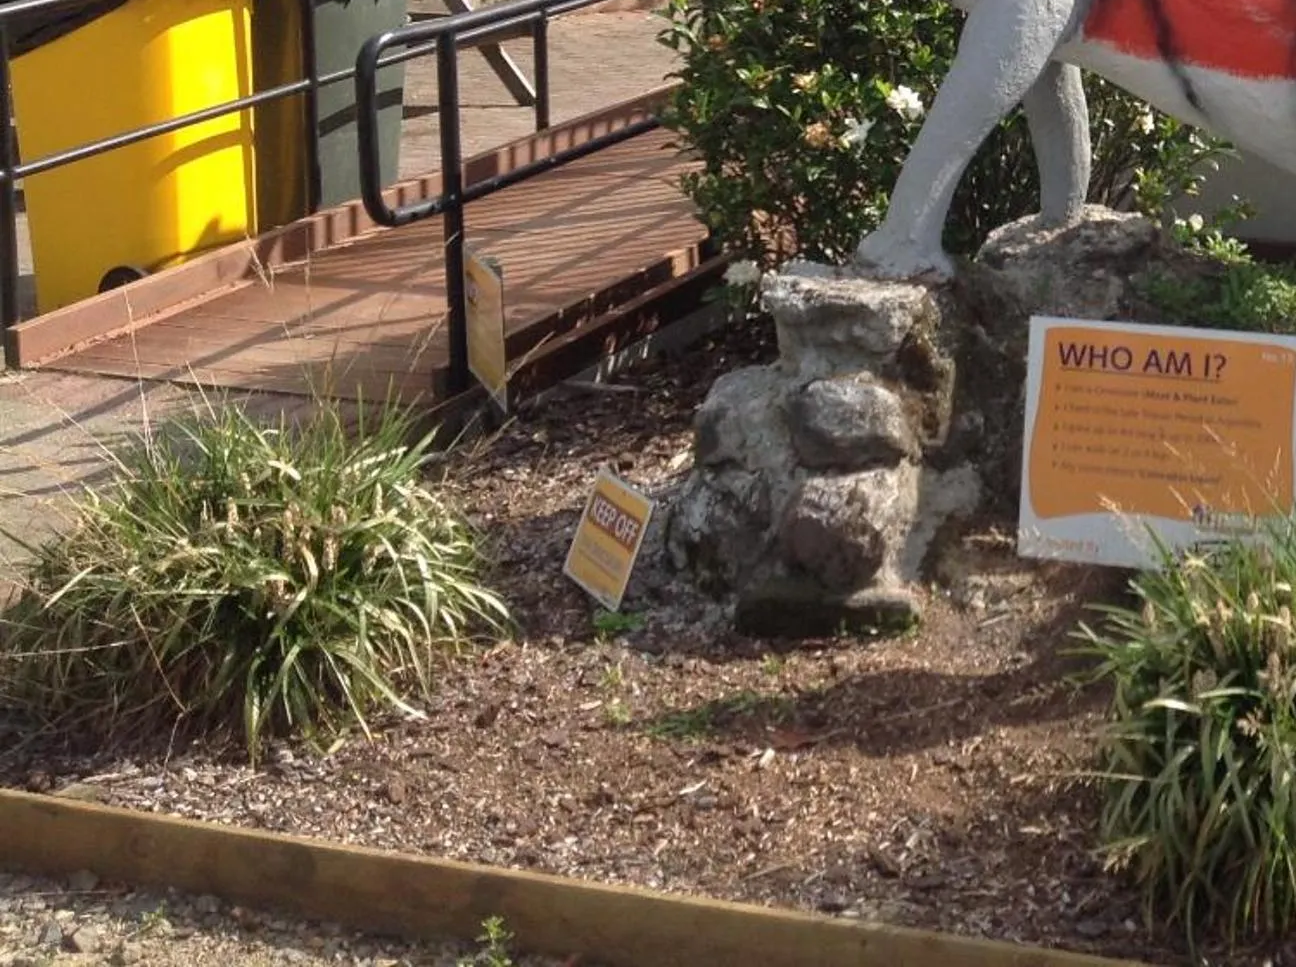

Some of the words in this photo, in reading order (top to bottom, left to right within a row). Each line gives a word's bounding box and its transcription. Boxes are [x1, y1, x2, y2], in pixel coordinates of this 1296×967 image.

[1058, 341, 1133, 371] WHO
[1142, 349, 1193, 377] AM
[1204, 353, 1229, 379] I?
[593, 496, 617, 527] KEEP
[615, 515, 639, 543] OFF
